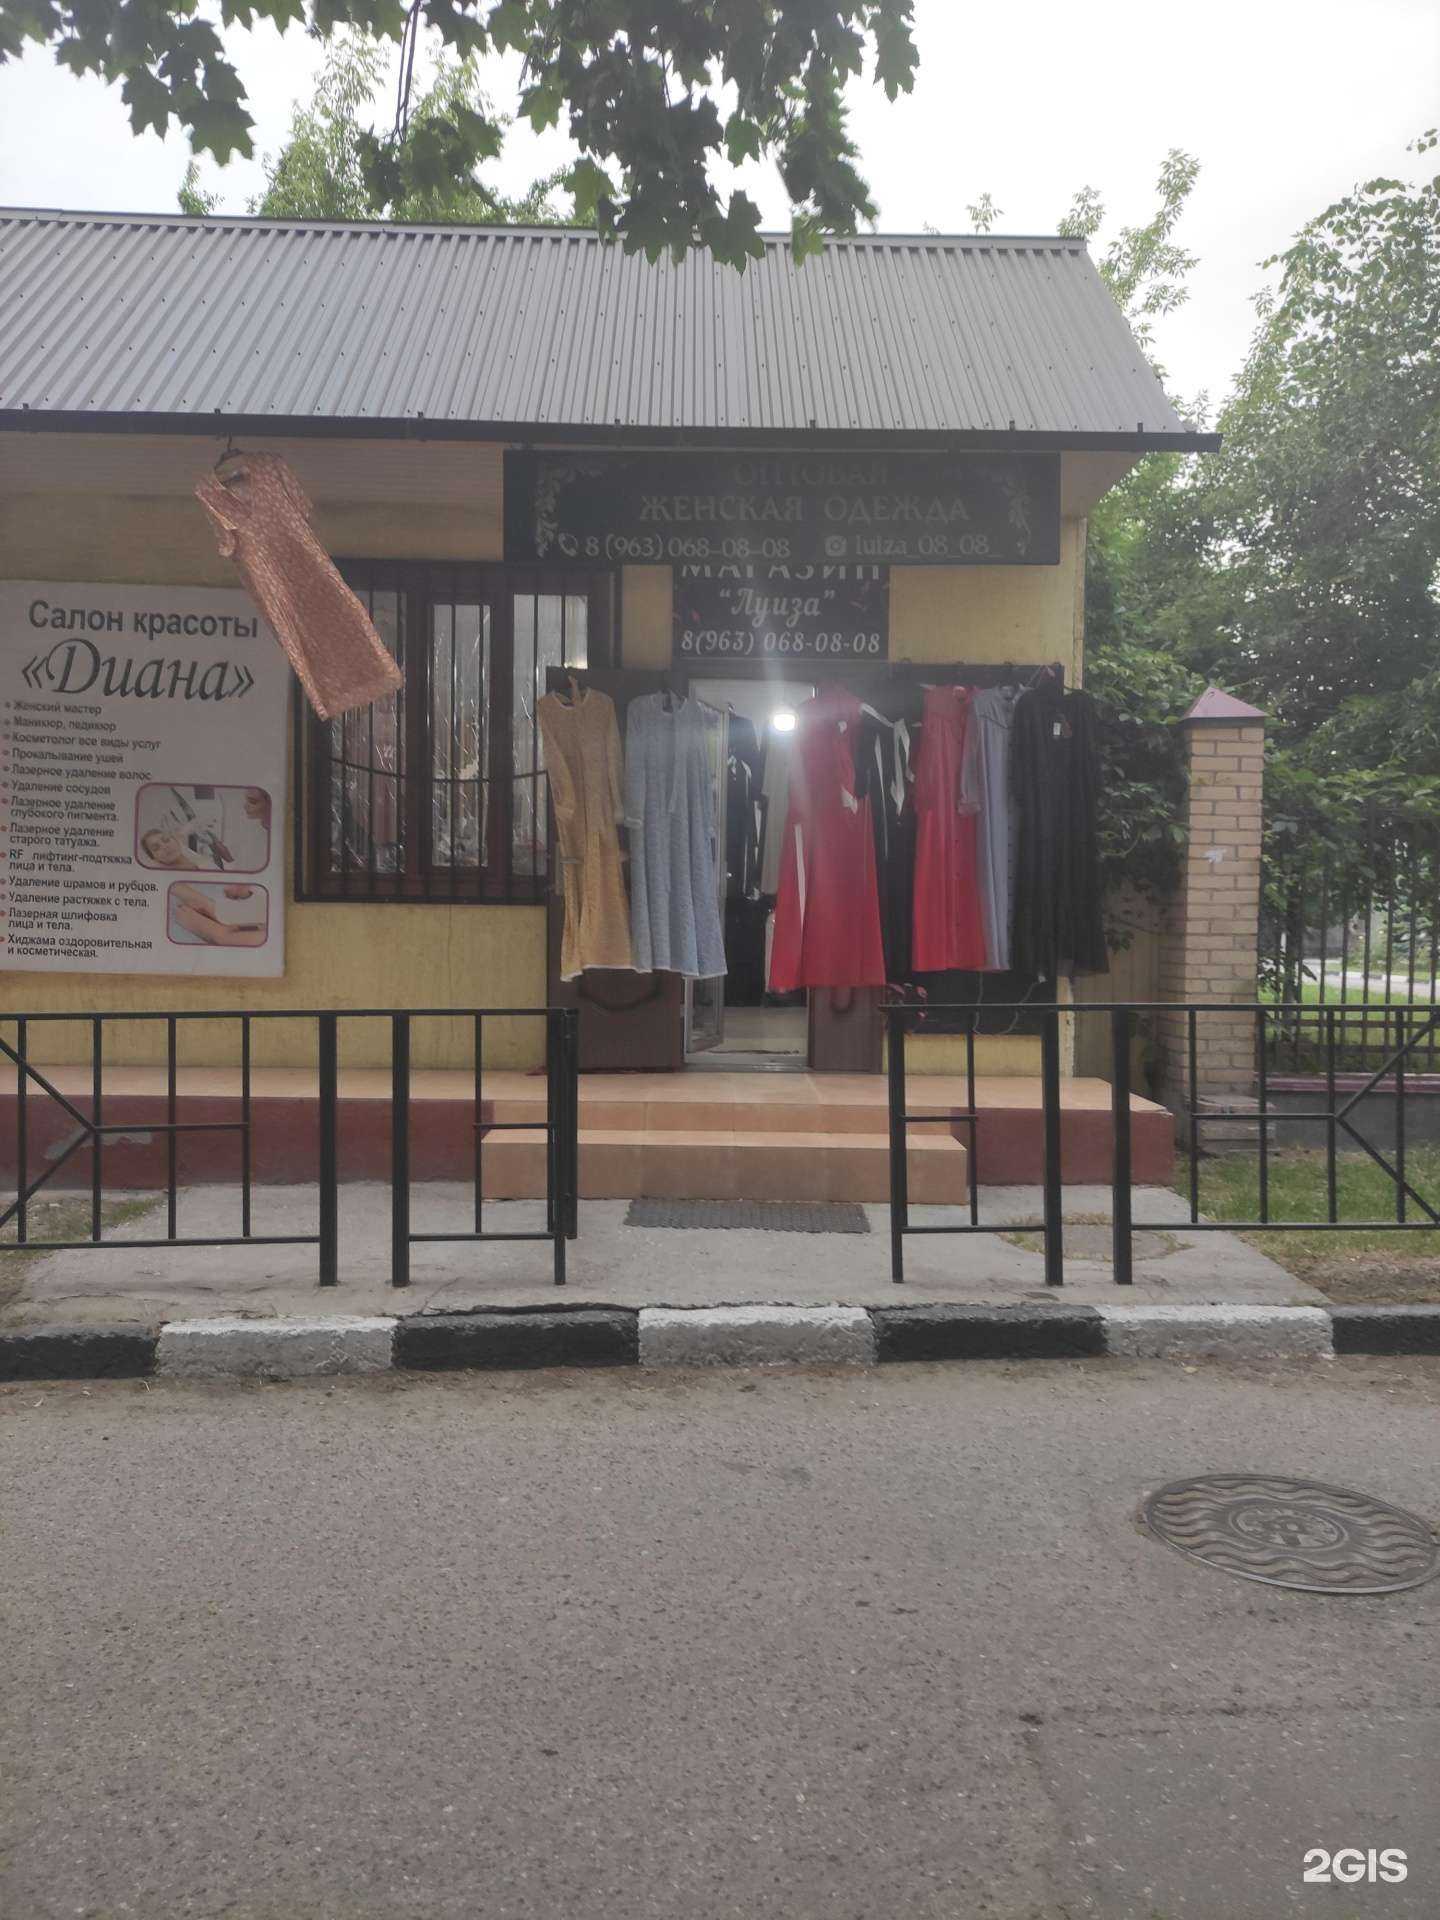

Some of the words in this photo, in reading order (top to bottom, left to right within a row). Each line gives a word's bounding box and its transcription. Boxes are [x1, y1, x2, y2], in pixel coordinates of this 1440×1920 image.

[639, 495, 803, 521] ЖЕНСКАЯ
[823, 496, 970, 525] ОДЕЖДА
[28, 599, 124, 633] Салон
[133, 608, 259, 641] красоты
[763, 631, 881, 654] 068-08-08
[21, 637, 255, 701] «Диана»
[13, 701, 62, 713] Женский
[64, 703, 102, 716] мастер
[68, 720, 117, 733] педикюр
[12, 733, 75, 746] Косметолог
[79, 737, 97, 746] все
[101, 738, 129, 749] виды
[132, 740, 161, 751] услуг
[12, 748, 93, 761] Прокалывание
[95, 753, 124, 764] ушей
[12, 764, 63, 777] Лазерное
[65, 768, 117, 779] удаление
[119, 771, 151, 781] волос
[12, 780, 63, 792] Удаление
[66, 784, 111, 796] сосудов
[11, 796, 61, 808] Лазерное
[64, 800, 116, 811] удаление
[10, 807, 64, 820] глубокого
[10, 822, 60, 835] Лазерное
[63, 827, 115, 838] удаление
[9, 835, 50, 846] старого
[9, 861, 35, 872] лица
[9, 875, 60, 888] Удаление
[63, 880, 106, 890] шрамов
[118, 881, 160, 893] рубцов.
[9, 891, 60, 904] Удаление
[63, 896, 112, 907] растяжек
[123, 898, 150, 908] тела.
[9, 907, 58, 920] Лазерная
[61, 909, 118, 923] шлифовка
[8, 919, 34, 930] лица
[46, 921, 73, 931] тела.
[8, 933, 56, 946] Хиджама
[58, 937, 153, 950] оздоровительная
[16, 946, 99, 958] косметическая.
